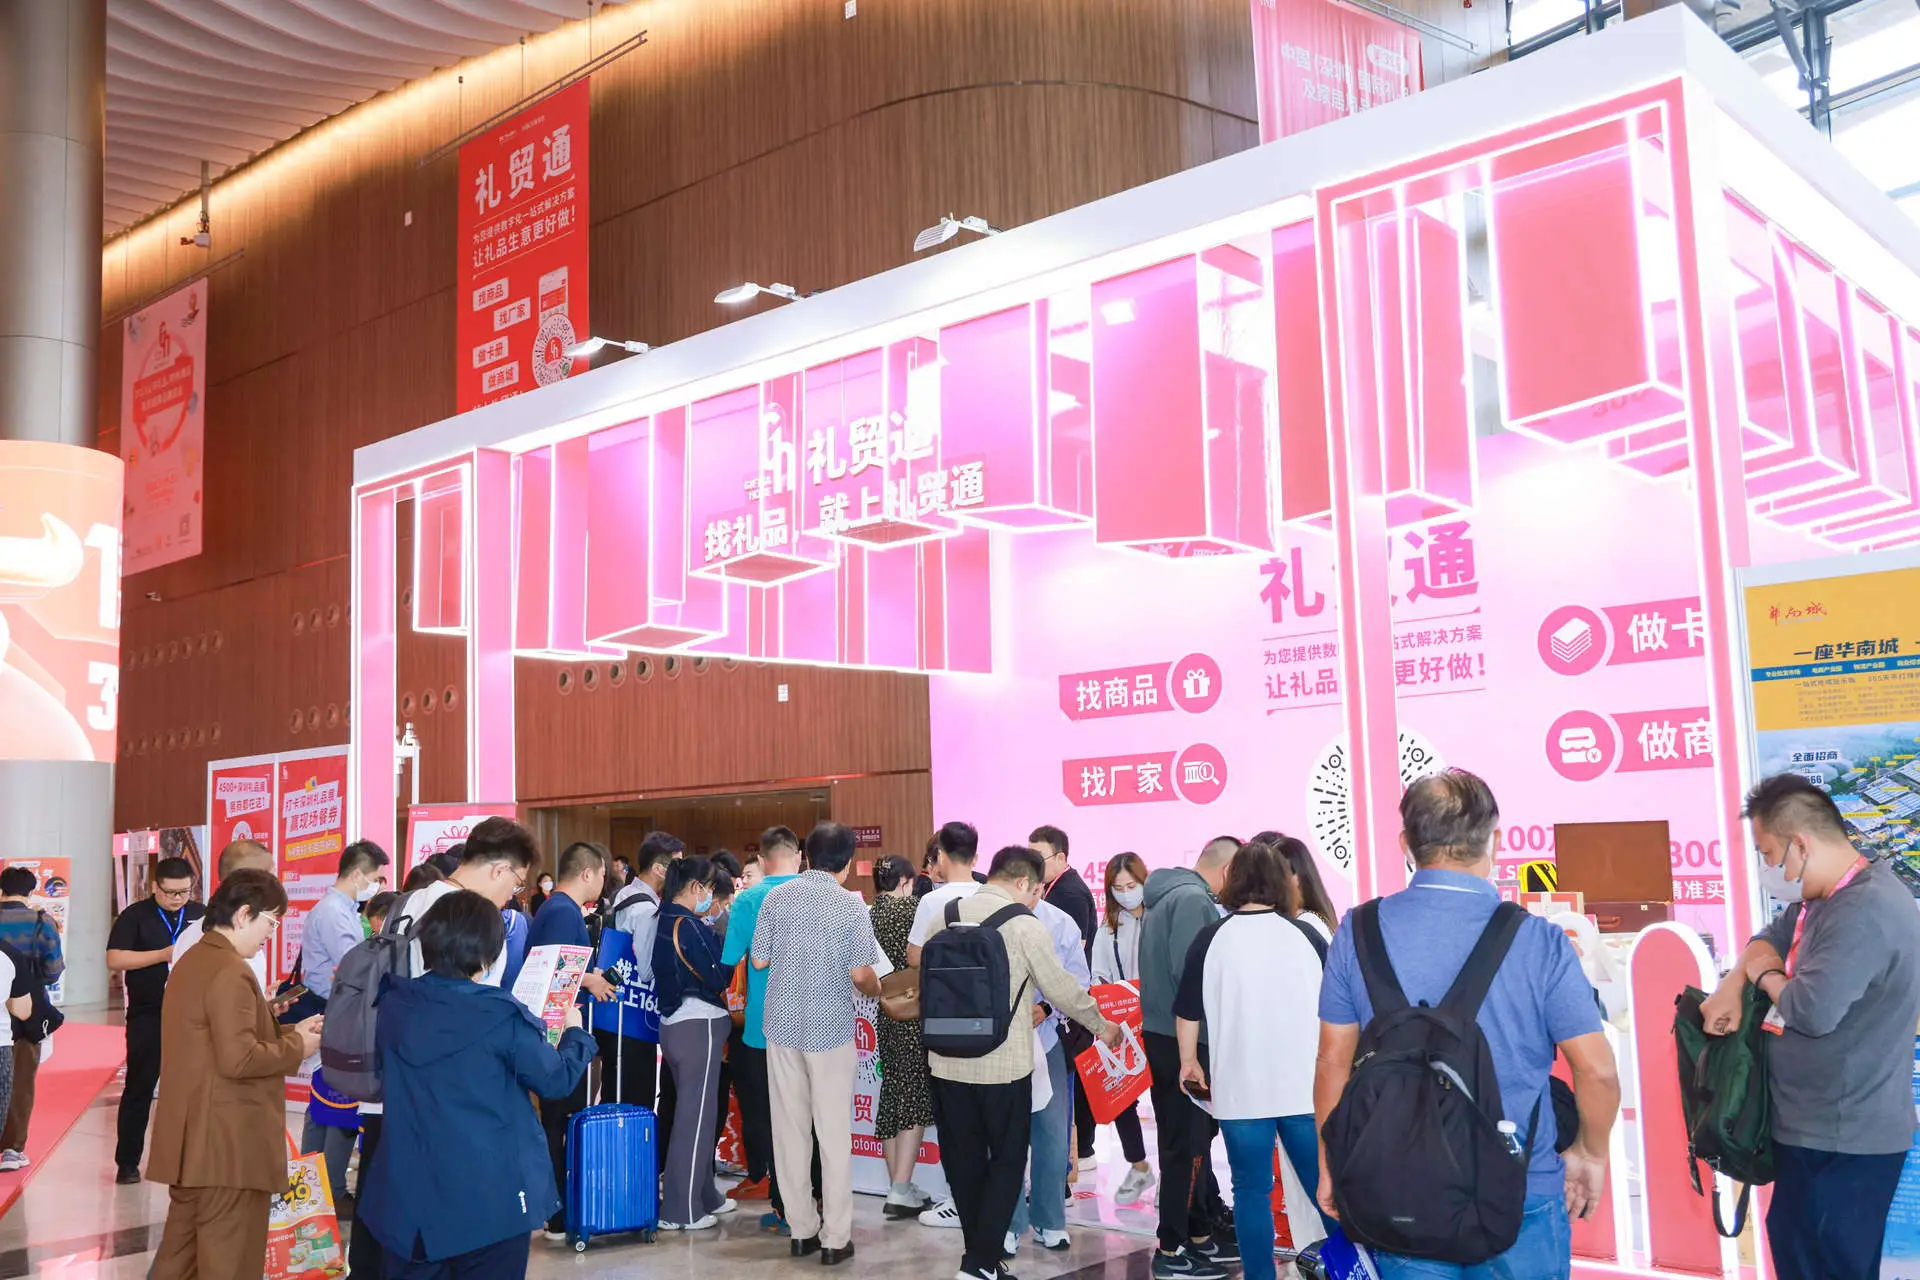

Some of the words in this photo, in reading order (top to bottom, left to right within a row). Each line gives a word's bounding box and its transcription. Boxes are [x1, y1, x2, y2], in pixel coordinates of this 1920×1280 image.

[475, 123, 571, 215] 礼贸通
[478, 283, 503, 306] 找商品
[499, 303, 525, 326] 找厂家
[1260, 520, 1479, 623] 礼通
[1794, 637, 1899, 661] 一座华南城
[1076, 674, 1158, 712] 找商品
[1792, 751, 1838, 763] 全面招商
[1081, 761, 1164, 798] 找厂家
